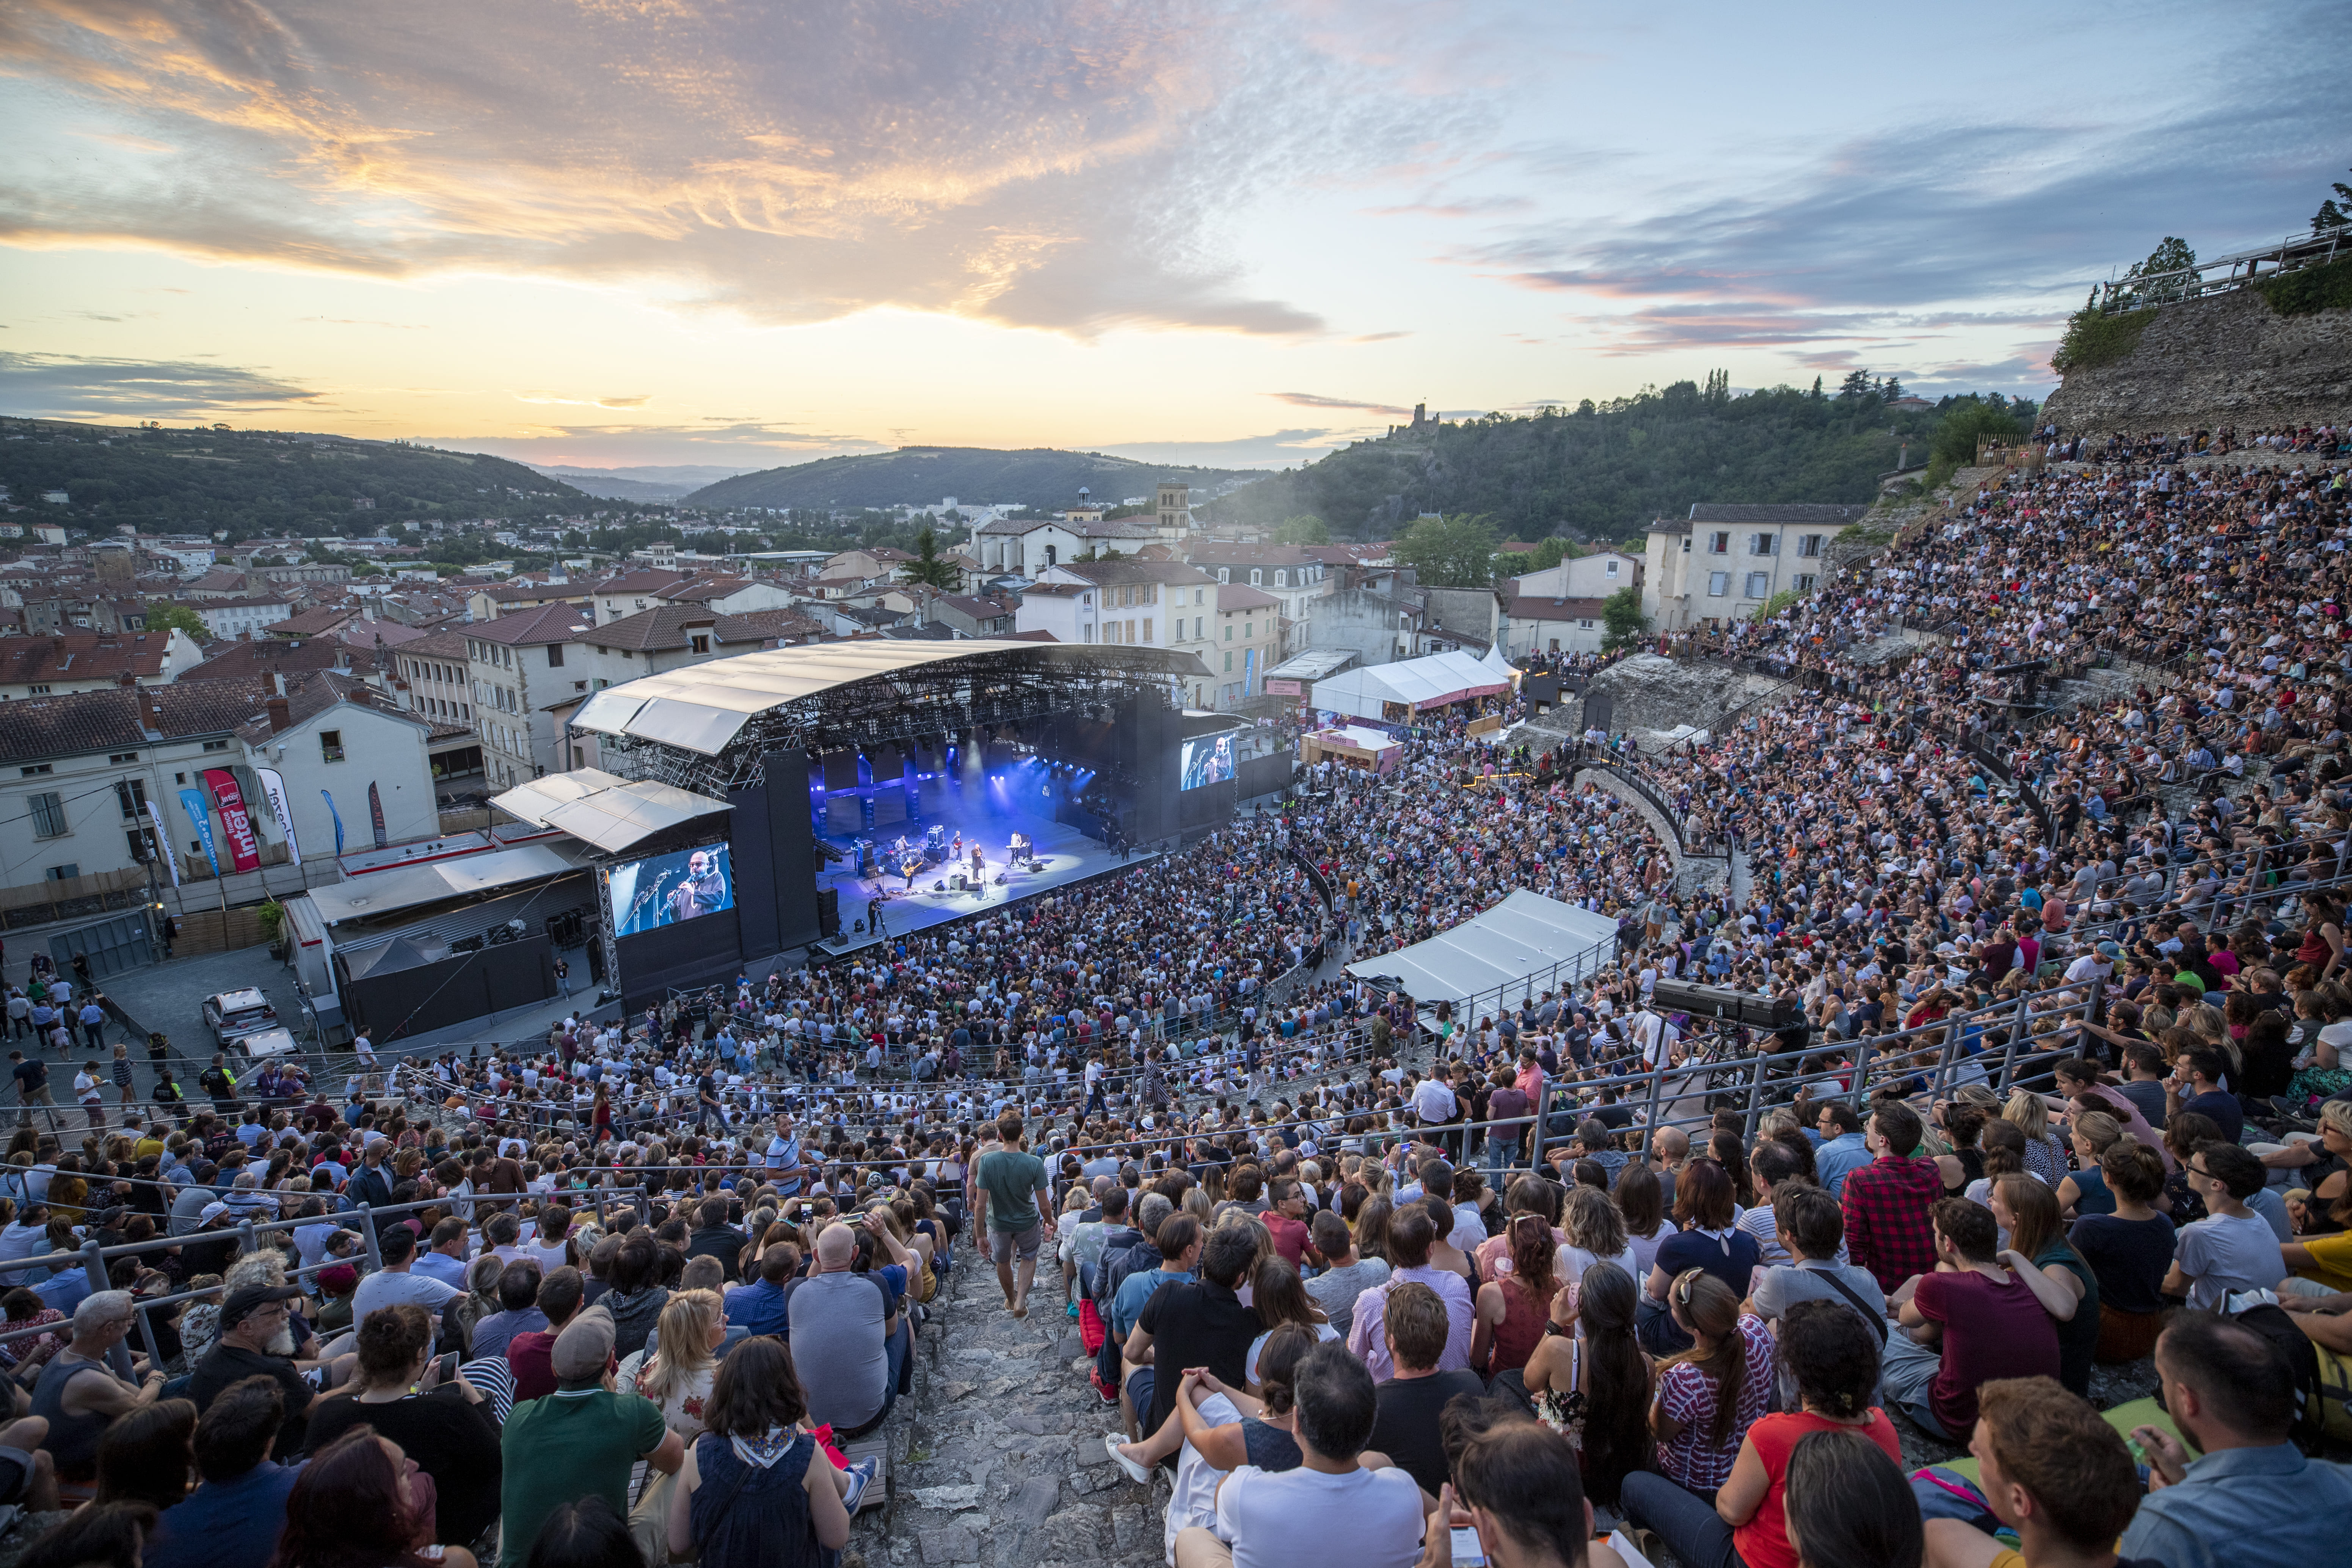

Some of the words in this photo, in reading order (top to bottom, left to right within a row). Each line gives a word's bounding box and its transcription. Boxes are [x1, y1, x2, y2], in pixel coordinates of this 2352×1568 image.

[1327, 735, 1346, 744] CASHLESS
[221, 794, 238, 803] inter
[223, 811, 235, 834] france
[229, 810, 257, 859] inter
[207, 1140, 233, 1152] POLO
